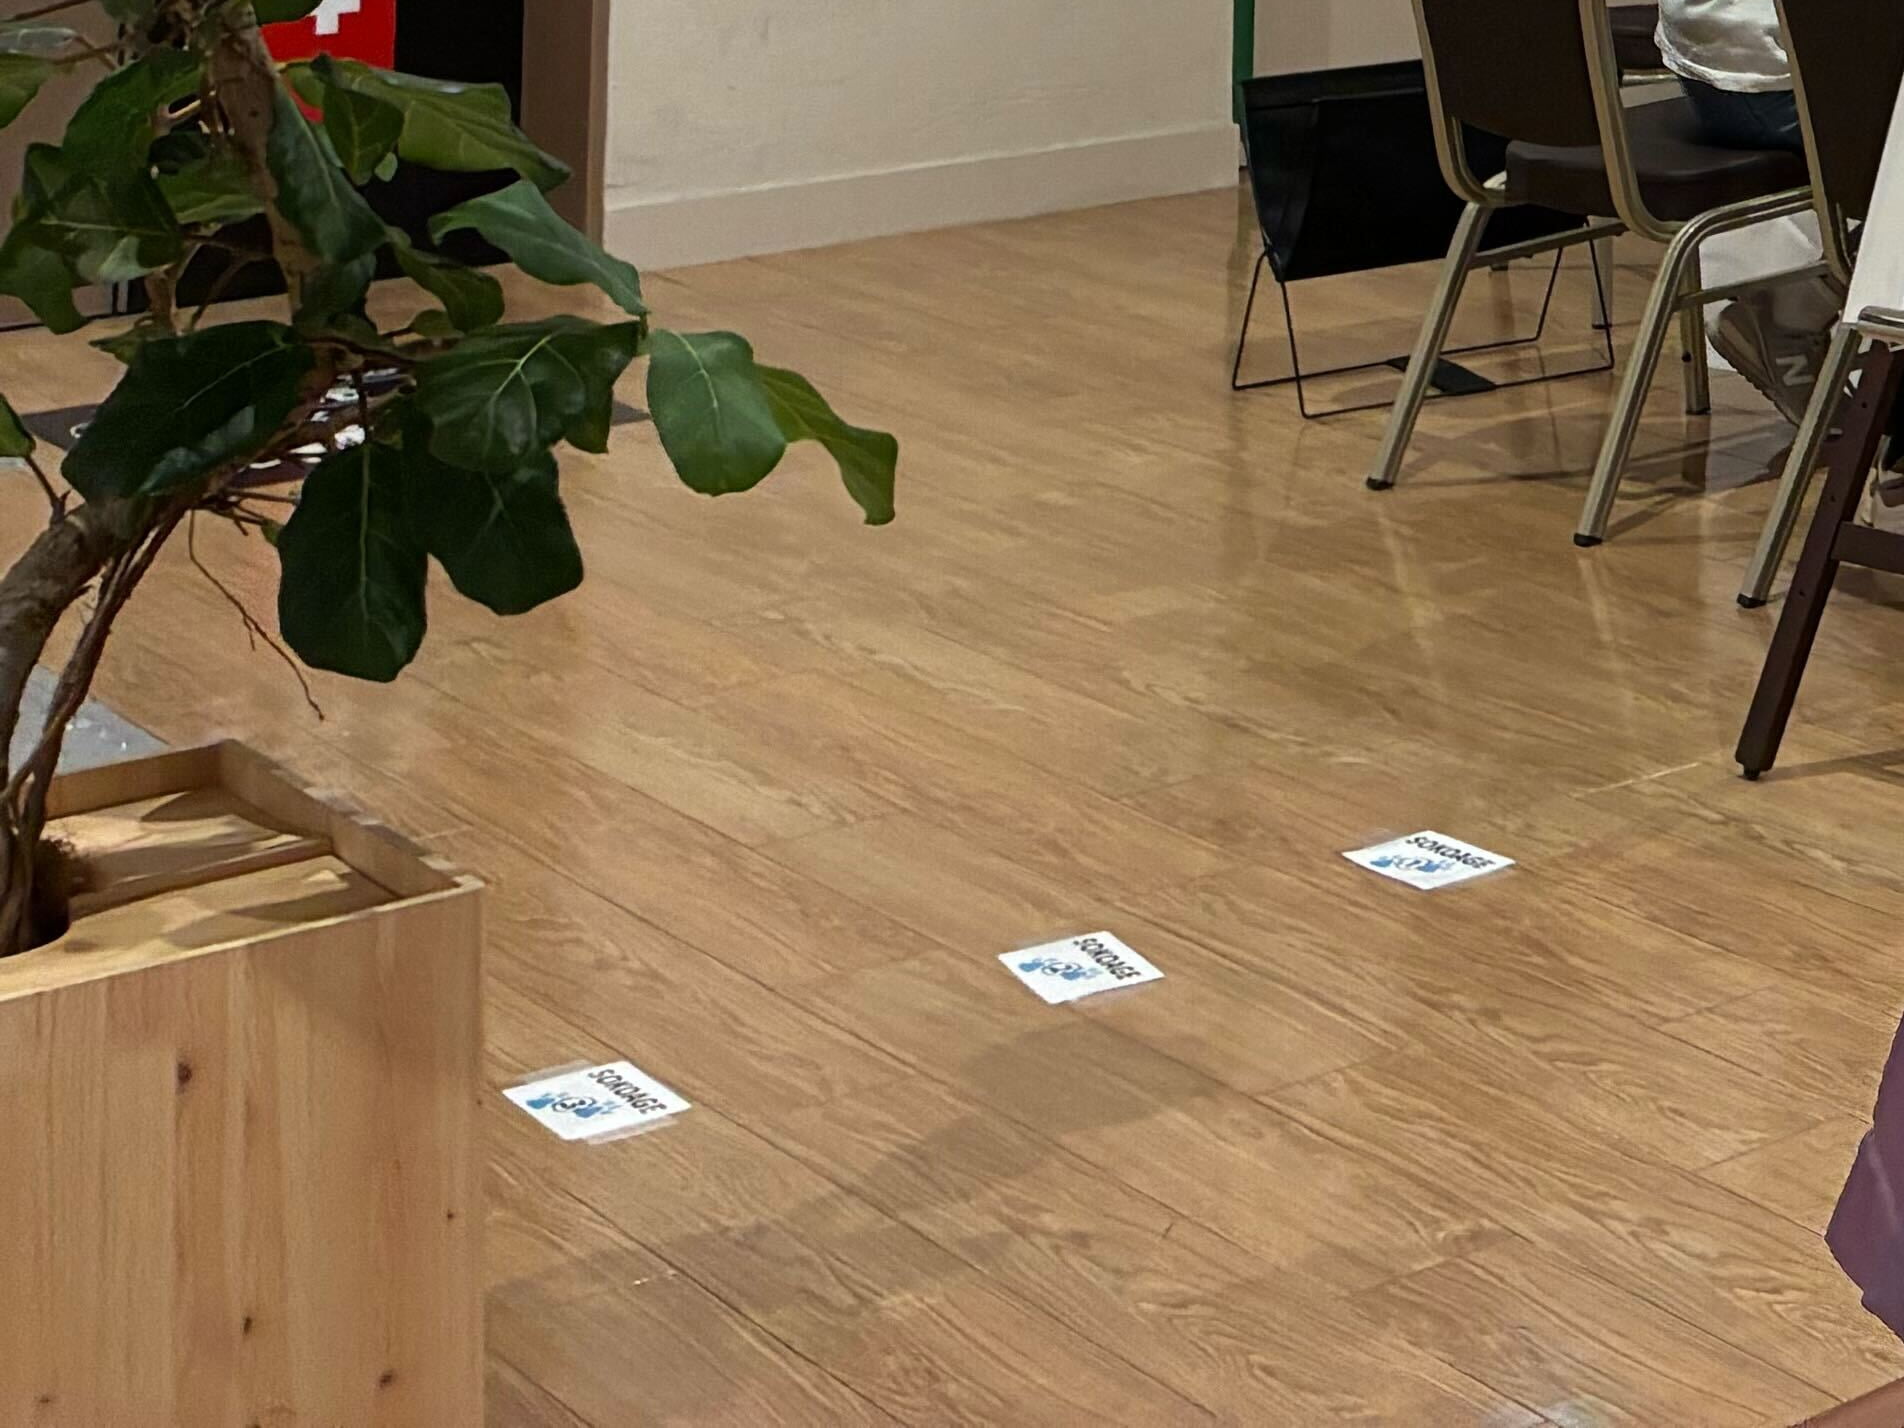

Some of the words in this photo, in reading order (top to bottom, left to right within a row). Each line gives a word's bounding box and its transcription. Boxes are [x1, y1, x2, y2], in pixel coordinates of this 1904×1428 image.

[1405, 835, 1497, 870] SOKOAGE
[1072, 937, 1142, 981] SOKOAGE
[588, 1067, 668, 1115] SOKOAGE
